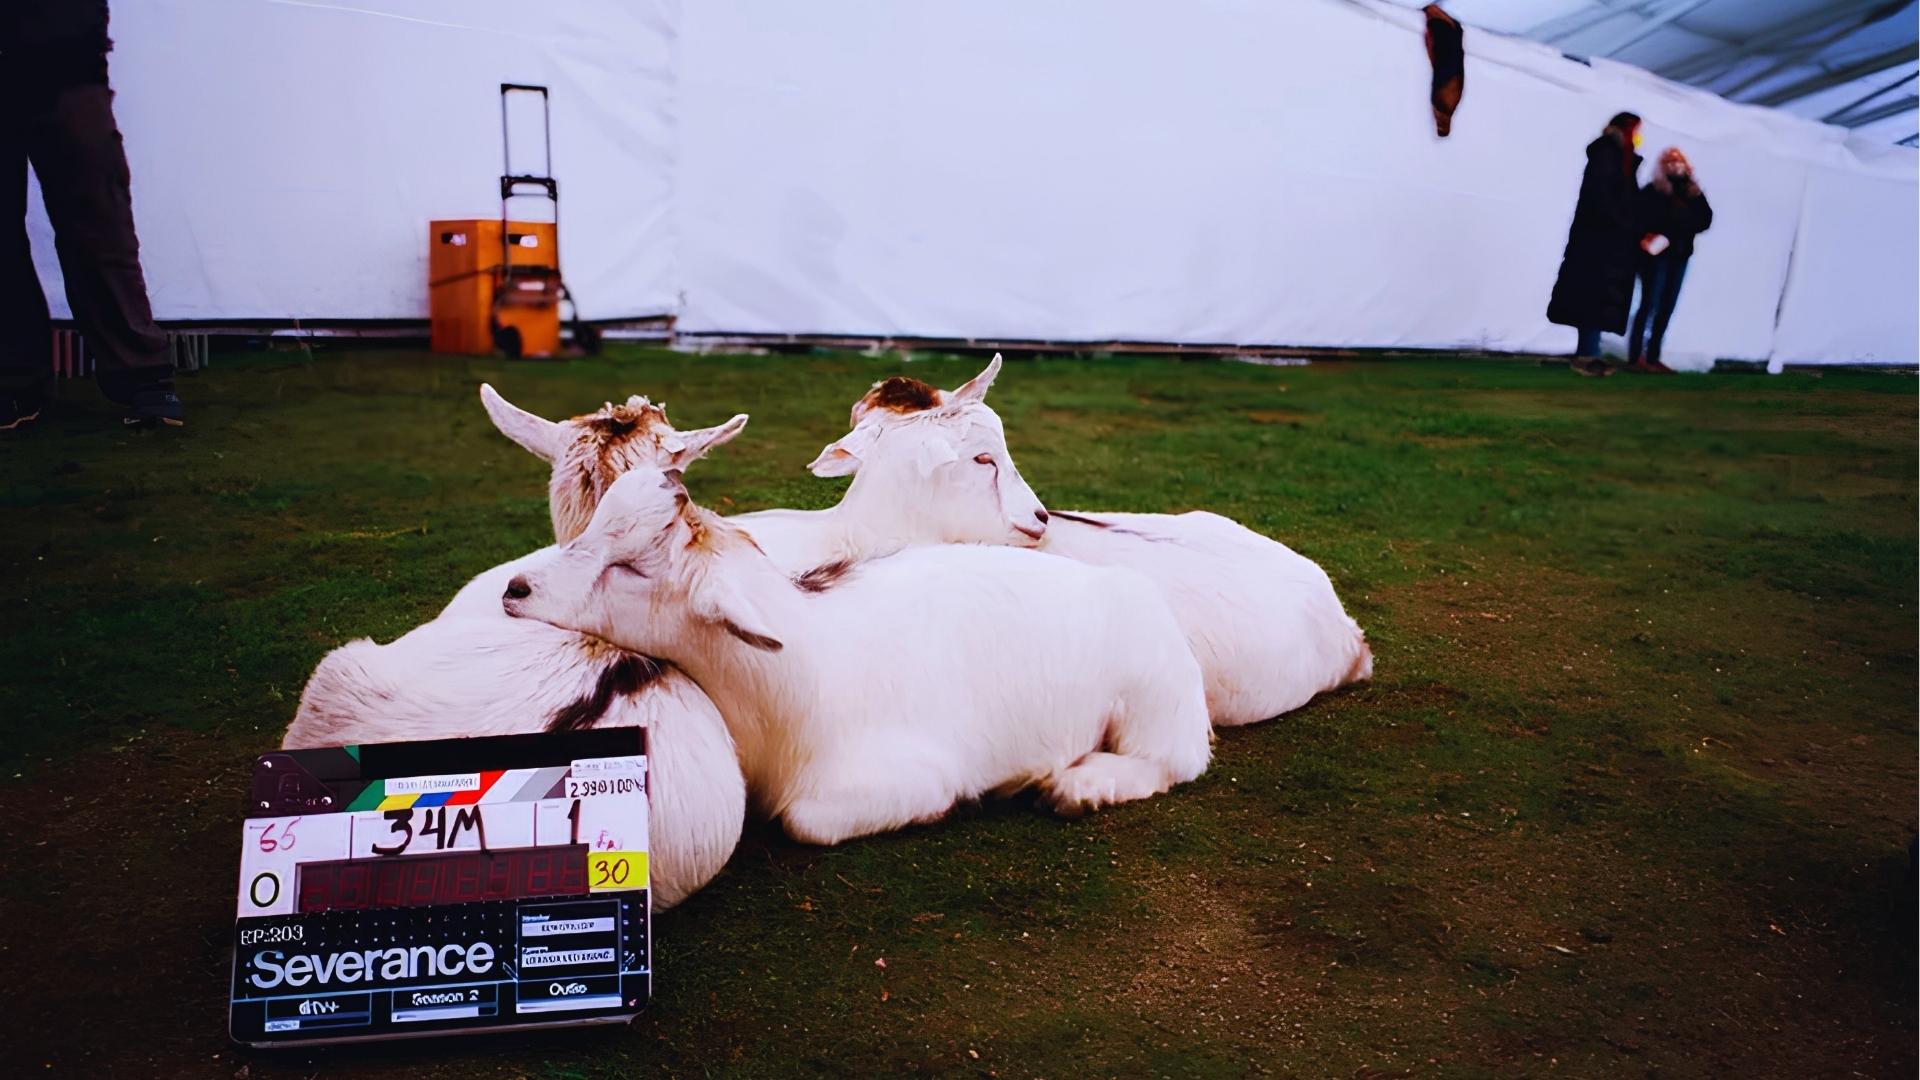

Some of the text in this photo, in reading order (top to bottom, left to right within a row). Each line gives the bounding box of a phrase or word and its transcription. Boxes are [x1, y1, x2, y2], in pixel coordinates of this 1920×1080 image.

[260, 817, 301, 853] 65
[372, 803, 494, 855] 34M
[567, 799, 581, 846] 1
[595, 858, 630, 886] 30
[251, 941, 495, 989] Severance
